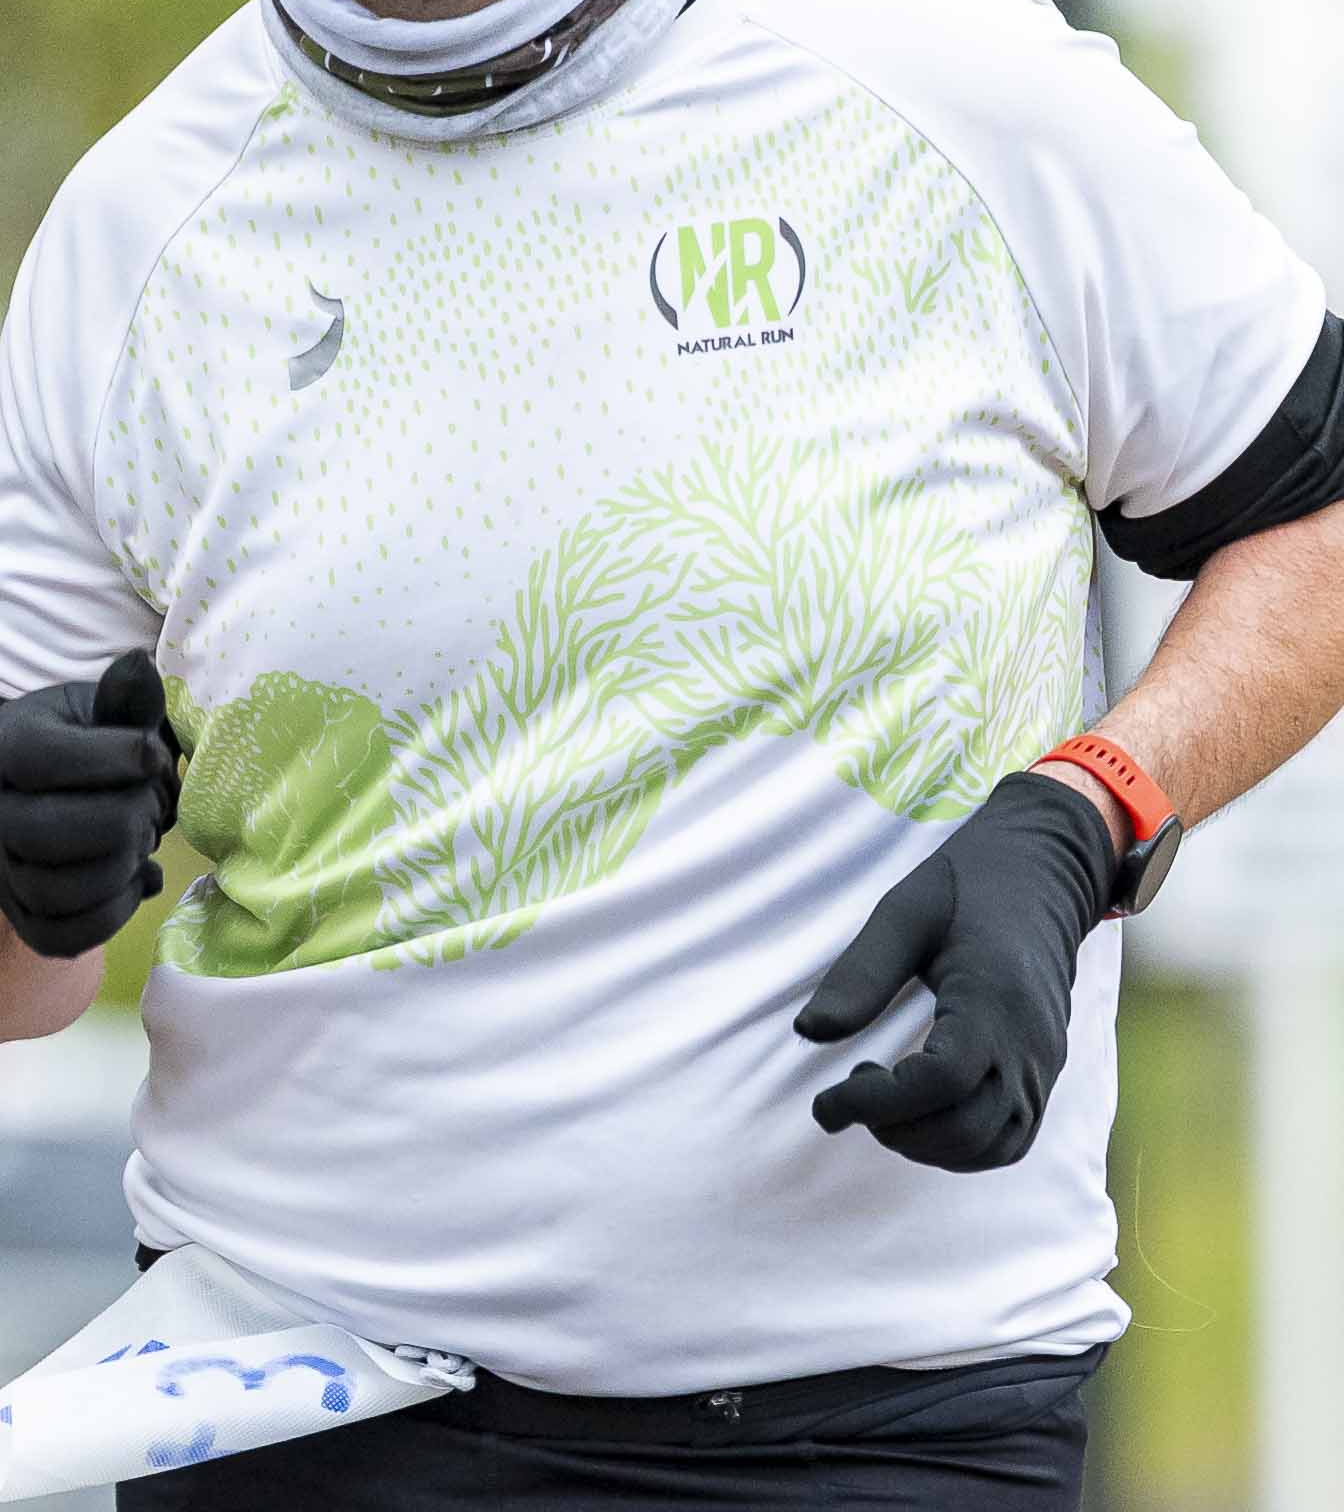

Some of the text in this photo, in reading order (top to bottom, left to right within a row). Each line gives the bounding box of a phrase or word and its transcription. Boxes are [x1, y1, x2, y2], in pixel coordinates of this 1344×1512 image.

[677, 218, 782, 329] NR
[677, 327, 794, 356] NATURAL RUN
